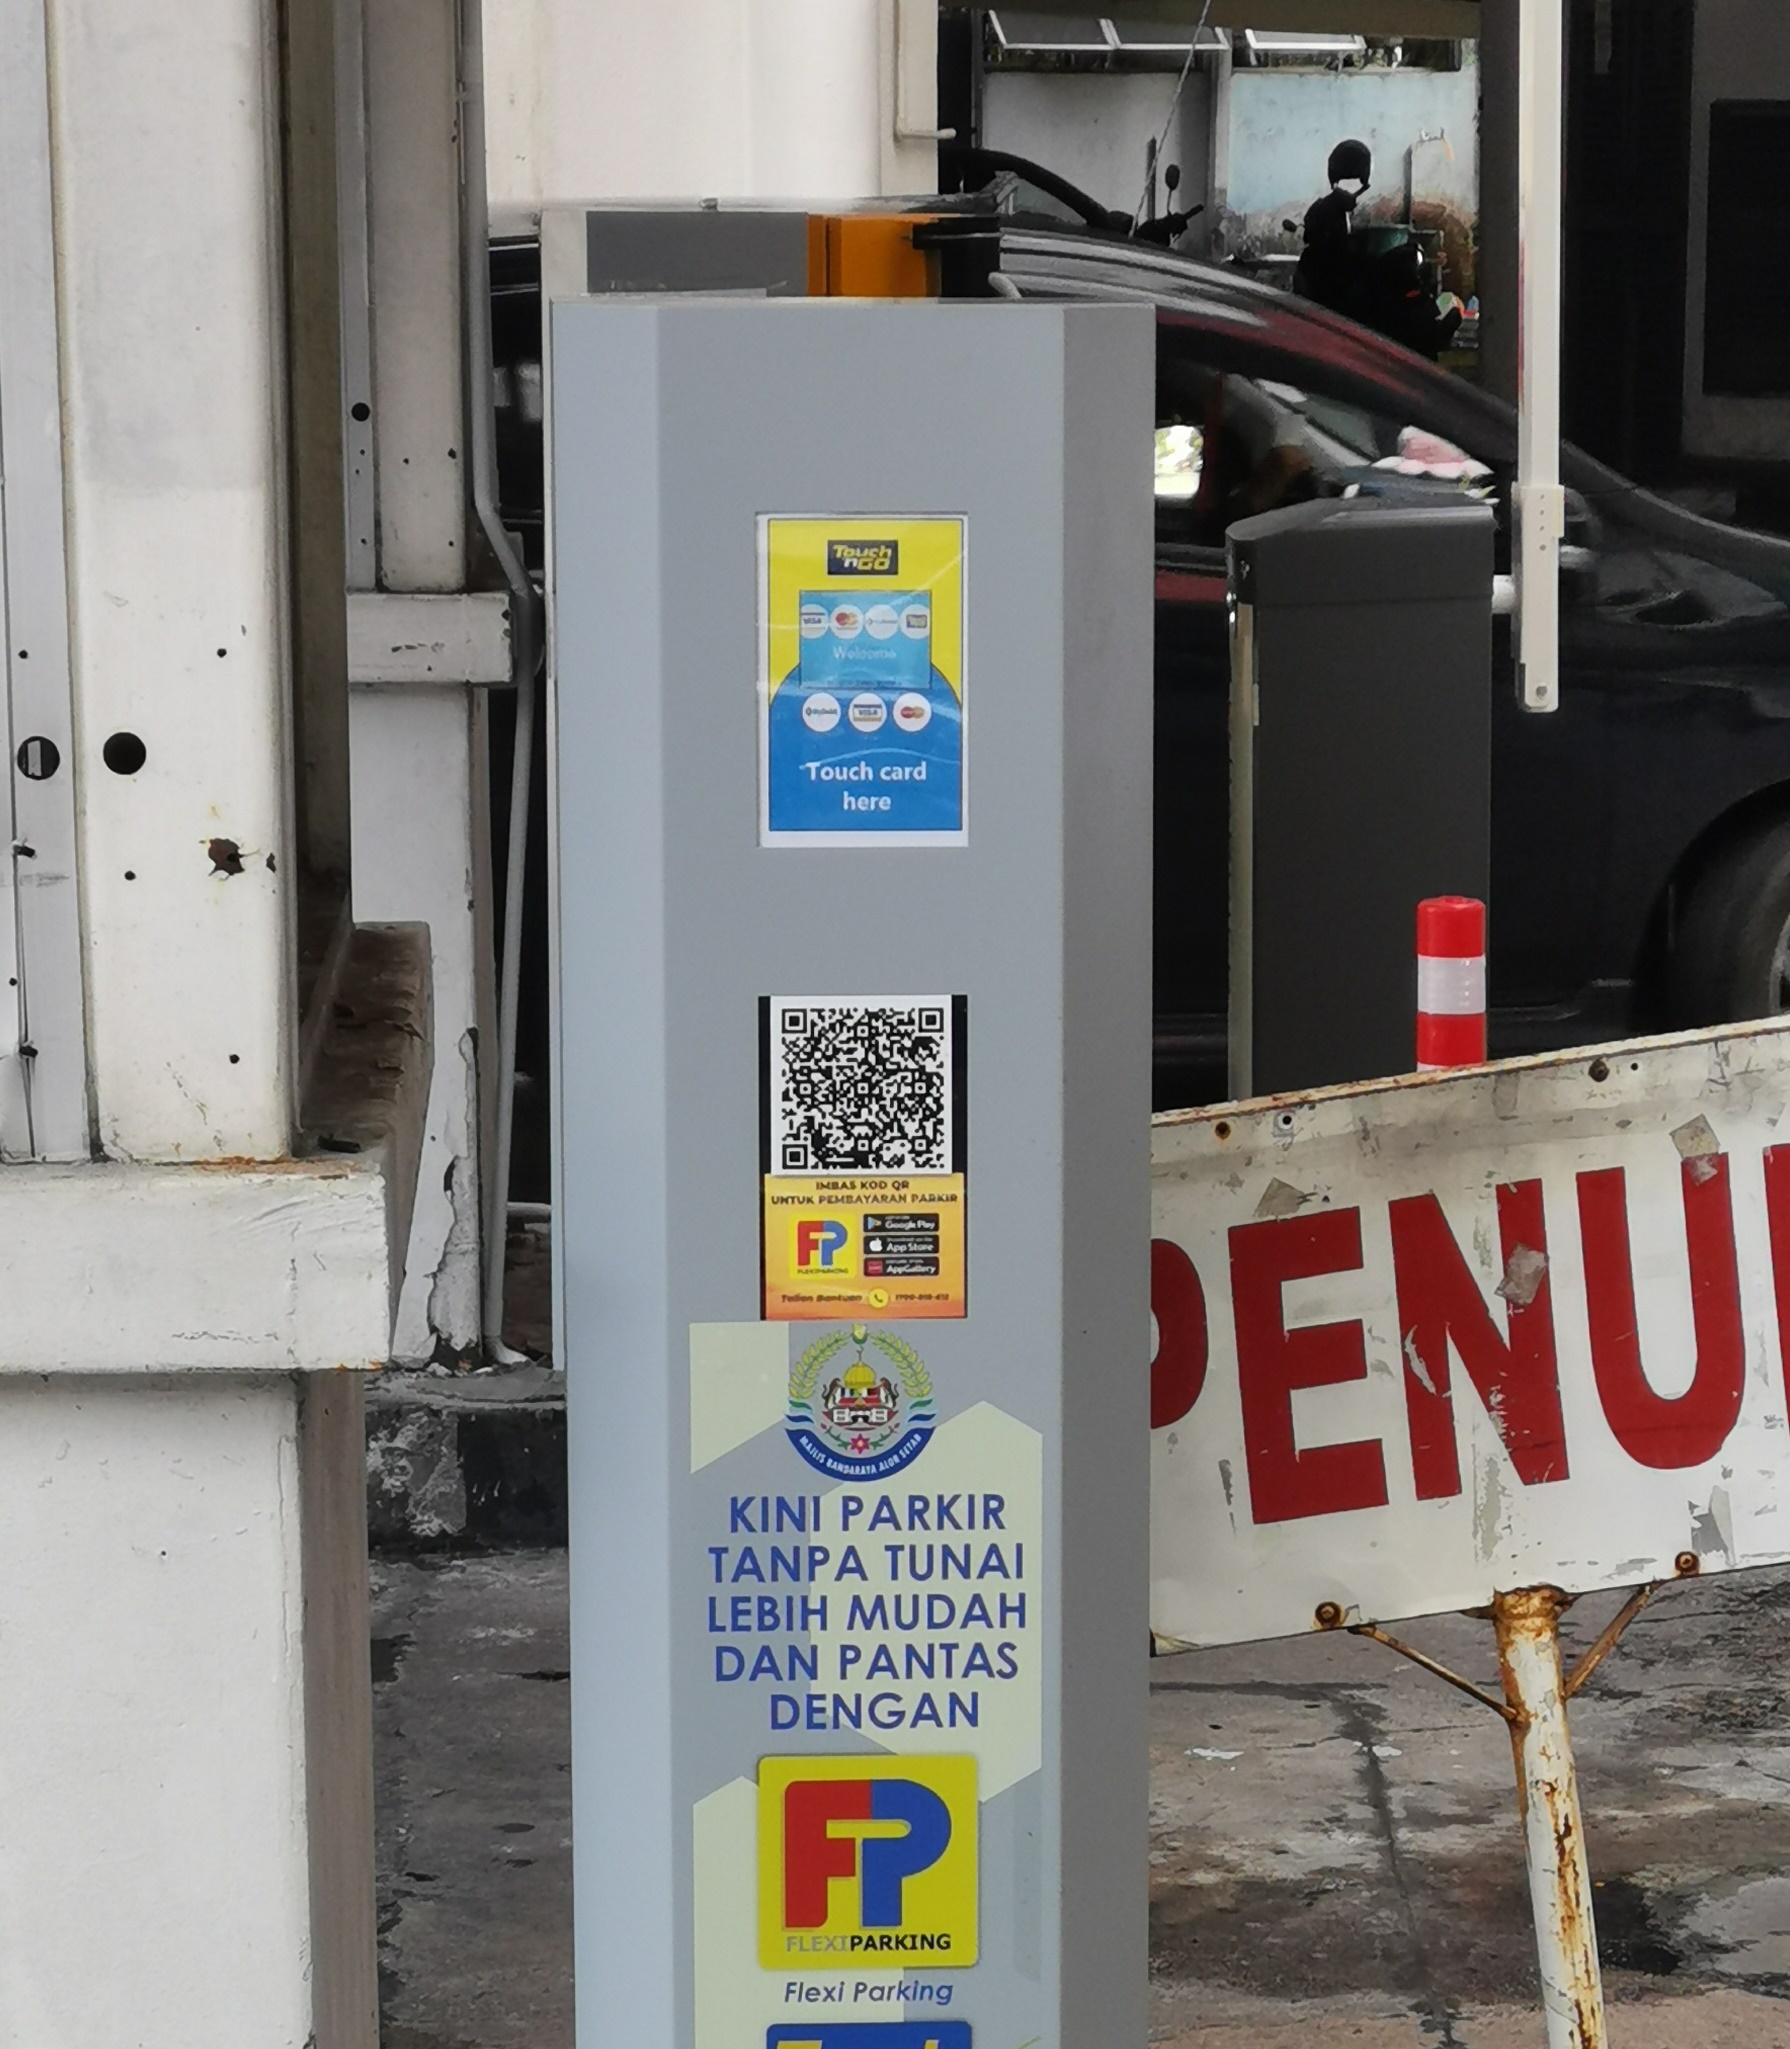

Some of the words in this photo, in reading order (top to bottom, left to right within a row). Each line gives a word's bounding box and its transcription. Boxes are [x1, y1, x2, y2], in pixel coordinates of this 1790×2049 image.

[833, 545, 892, 558] Touch
[832, 646, 897, 660] Welcome
[806, 761, 873, 781] Touch
[879, 760, 928, 781] card
[842, 791, 892, 811] here
[815, 1180, 857, 1191] IMBAS
[860, 1180, 888, 1190] KOD
[891, 1180, 910, 1191] QR
[771, 1195, 815, 1205] UNTUK
[818, 1193, 907, 1204] PEMBAYARAN
[910, 1193, 958, 1203] PARKIR
[885, 1220, 916, 1230] Google
[917, 1219, 936, 1230] Play
[886, 1242, 907, 1253] App
[907, 1242, 935, 1252] Store
[886, 1264, 936, 1274] AppGallery
[781, 1293, 814, 1303] Talian
[816, 1293, 863, 1303] Bantuan
[799, 1435, 827, 1464] MAJLIS
[826, 1457, 877, 1475] BANDARAYA
[878, 1454, 900, 1472] ALOR
[899, 1433, 923, 1460] SETAR
[729, 1496, 821, 1534] KINI
[841, 1493, 1007, 1532] PARKIR
[708, 1545, 869, 1584] TANPA
[884, 1542, 1024, 1582] TUNAI
[707, 1594, 828, 1633] LEBIH
[846, 1592, 1027, 1632] MUDAH
[715, 1644, 818, 1683] DAN
[839, 1641, 1019, 1681] PANTAS
[770, 1691, 980, 1731] DENGAN
[784, 1778, 953, 1929] FP
[786, 1933, 952, 1952] FLEXIPARKING
[783, 1981, 845, 2004] Flexi
[852, 1979, 954, 2006] Parking
